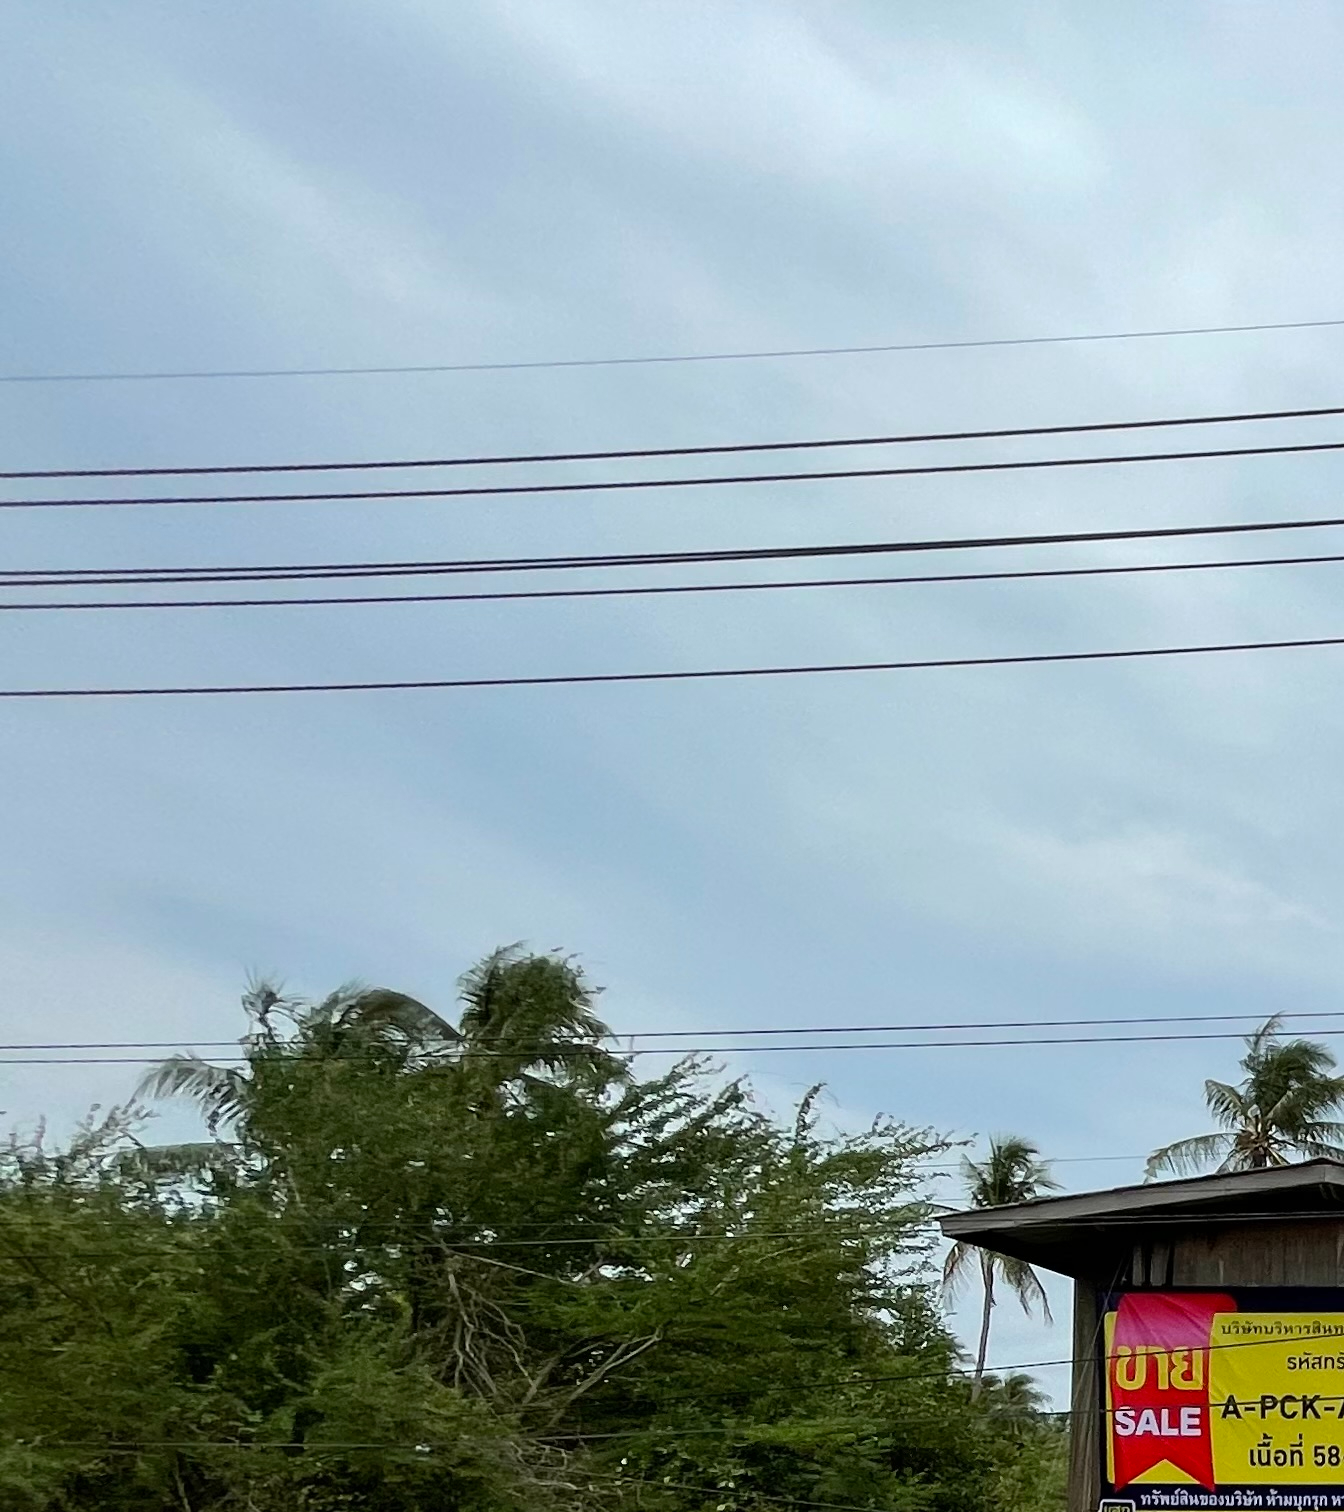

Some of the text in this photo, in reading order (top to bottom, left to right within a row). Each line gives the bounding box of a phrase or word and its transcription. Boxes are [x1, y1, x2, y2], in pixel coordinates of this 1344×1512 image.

[1116, 1345, 1204, 1391] ขาย
[1115, 1406, 1202, 1436] SALE
[1250, 1433, 1304, 1467] เนื้อที่
[1141, 1488, 1262, 1506] ทรัพย์สินของบริษัท
[1266, 1489, 1327, 1511] ห้ามบุกรุก
